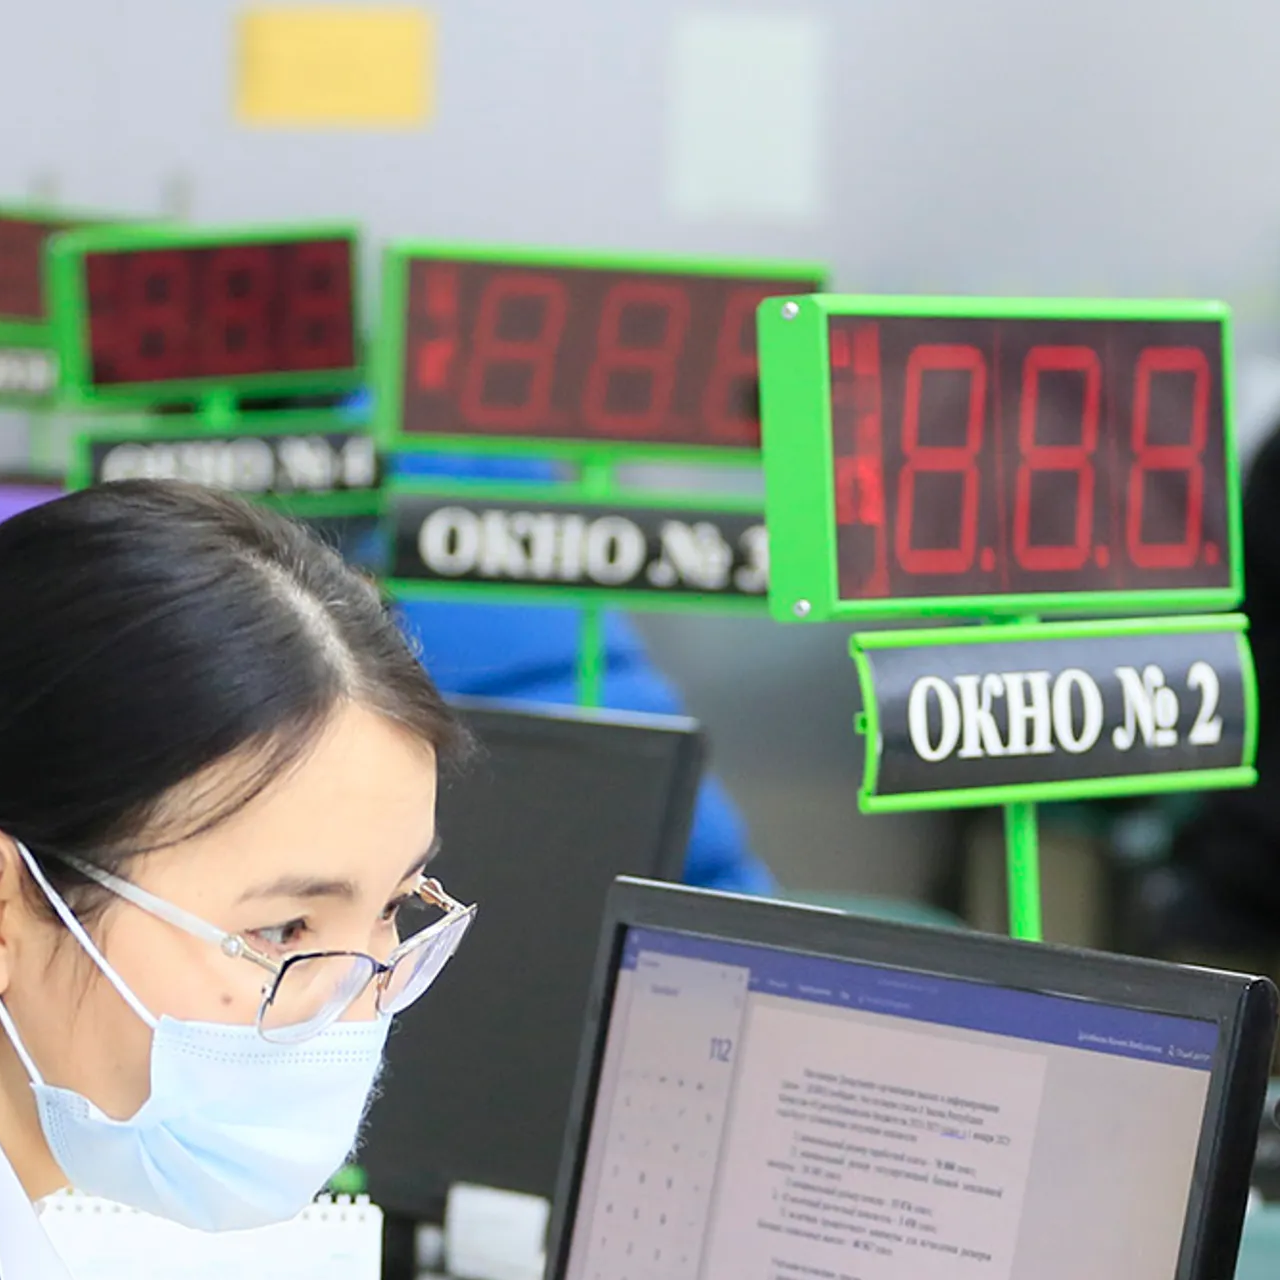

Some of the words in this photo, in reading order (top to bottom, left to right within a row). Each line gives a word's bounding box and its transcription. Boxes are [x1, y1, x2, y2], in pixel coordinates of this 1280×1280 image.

[419, 506, 646, 585] ОКНО
[646, 520, 732, 589] №
[908, 668, 1103, 761] ОКНО
[1112, 665, 1179, 751] №
[1187, 661, 1222, 745] 2
